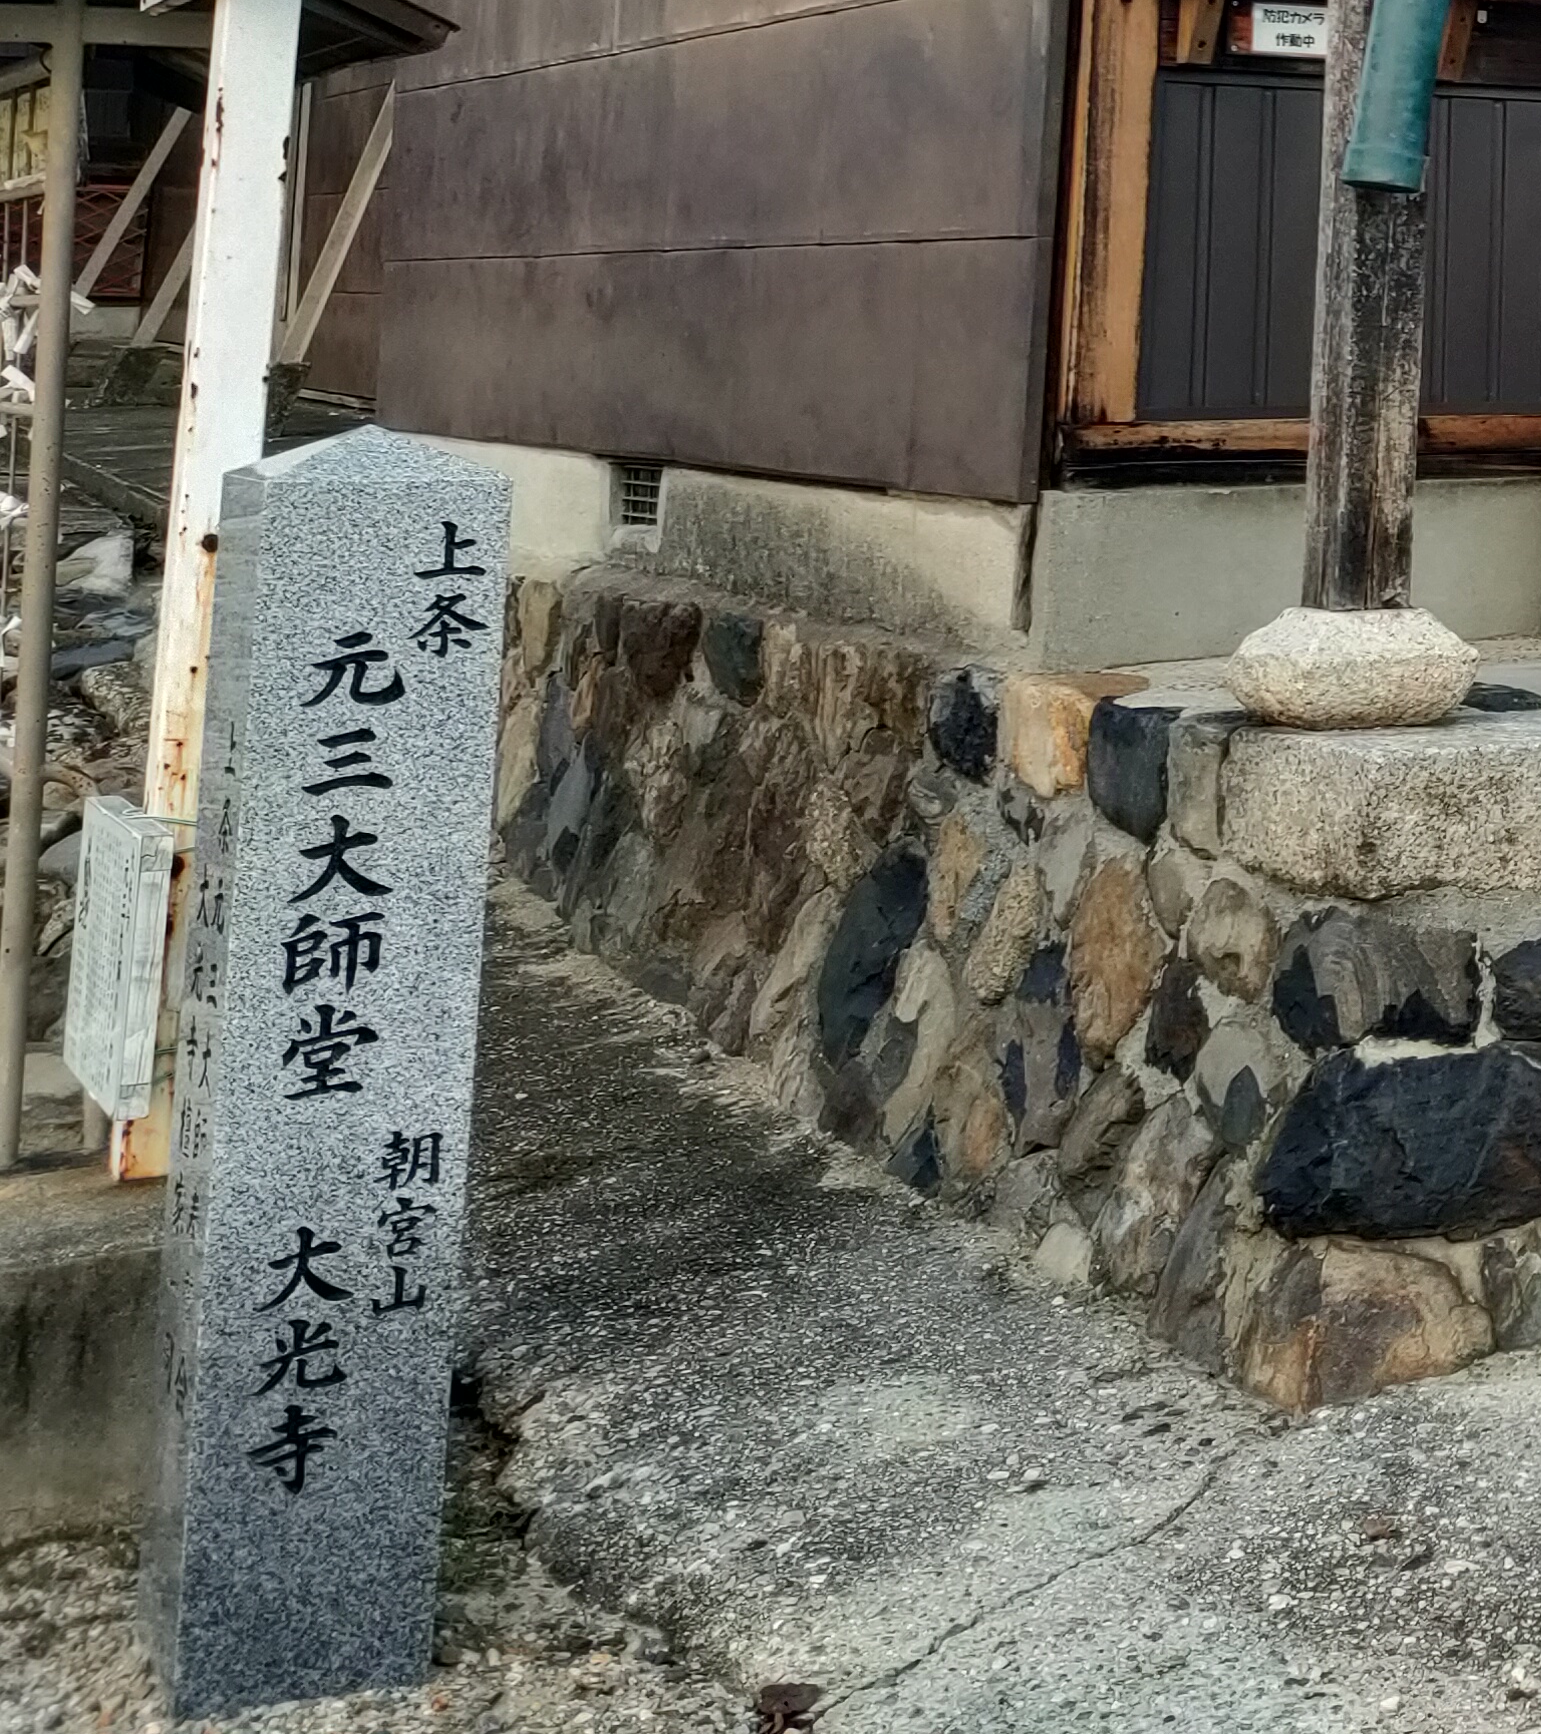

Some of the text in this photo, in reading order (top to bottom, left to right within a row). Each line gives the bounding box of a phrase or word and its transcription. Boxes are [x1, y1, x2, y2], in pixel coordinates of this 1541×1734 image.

[1261, 8, 1325, 25] 防犯カメラ
[1275, 33, 1315, 48] 作動中
[407, 519, 489, 658] 上条
[281, 630, 407, 1101] 元三大師堂
[368, 1129, 444, 1316] 朝宮山
[248, 1224, 355, 1496] 大光寺
